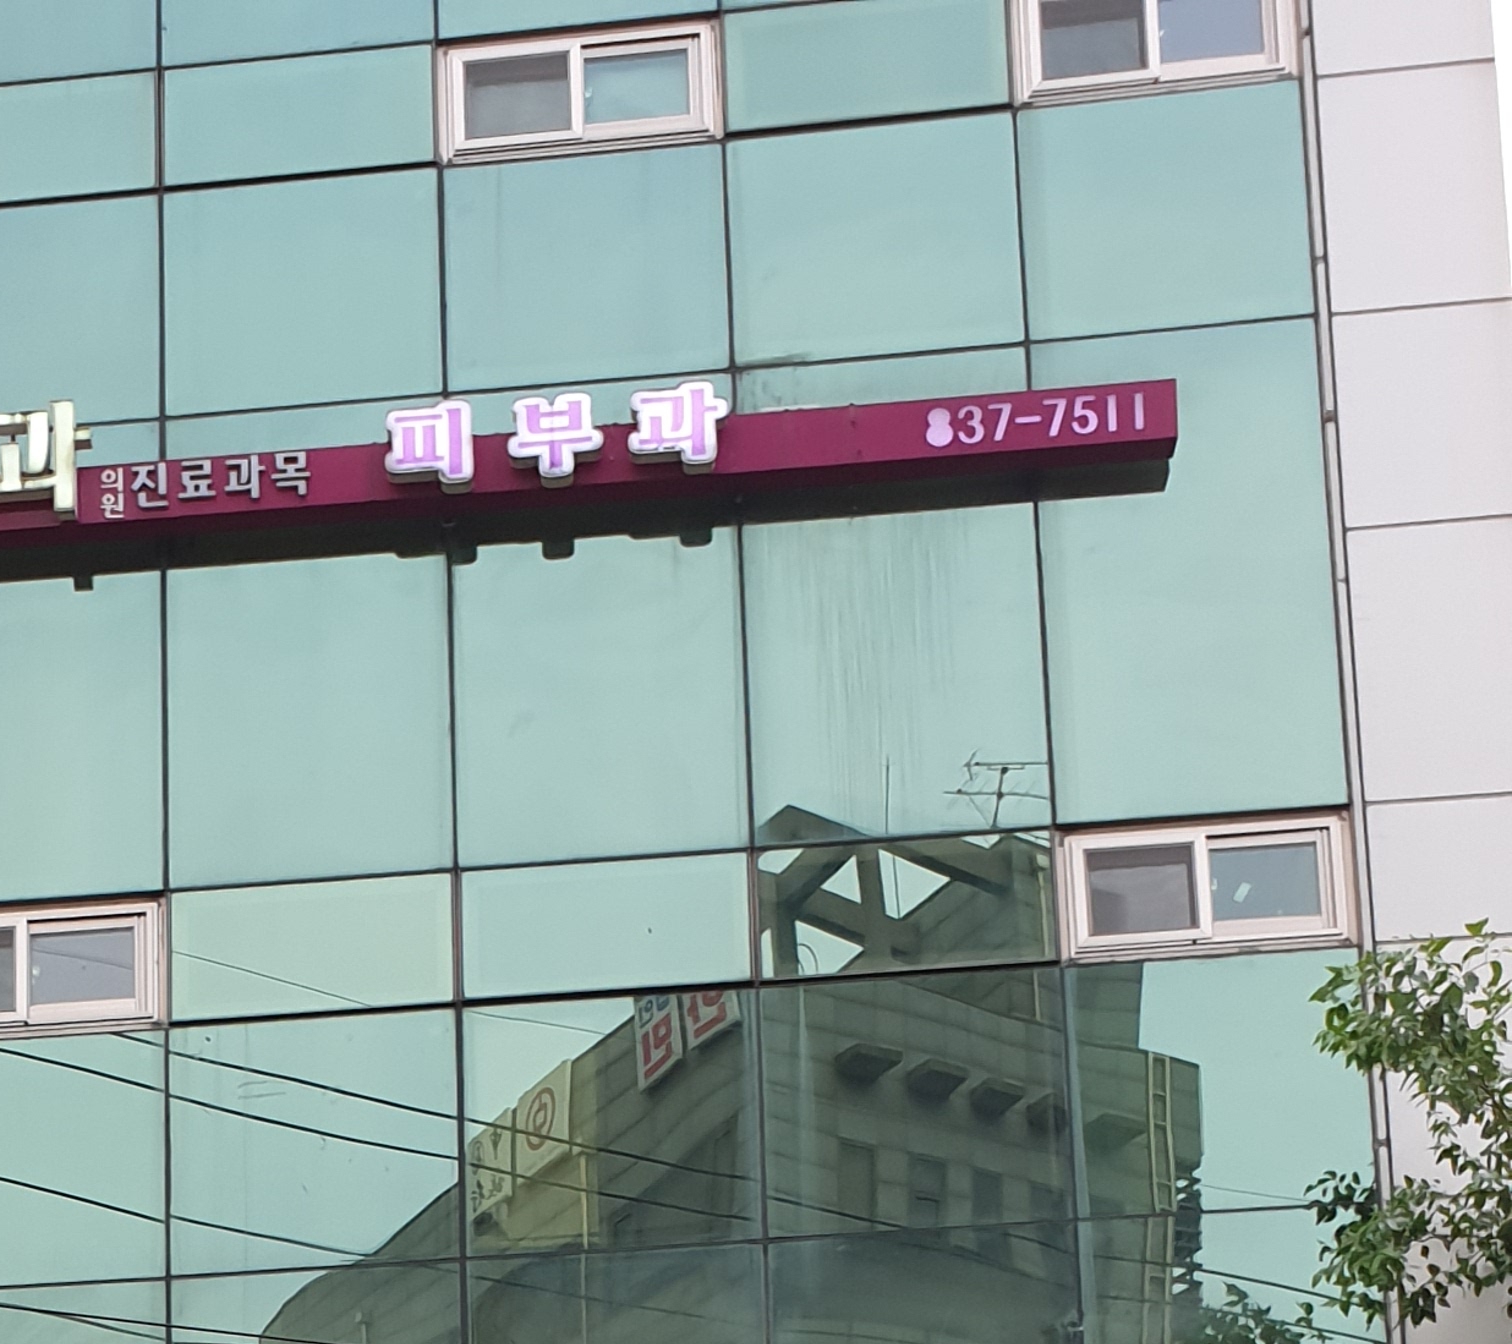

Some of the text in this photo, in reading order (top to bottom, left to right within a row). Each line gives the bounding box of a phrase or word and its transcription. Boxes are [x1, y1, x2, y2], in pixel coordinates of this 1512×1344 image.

[130, 381, 1145, 508] 진료과목 피부과 837-7511
